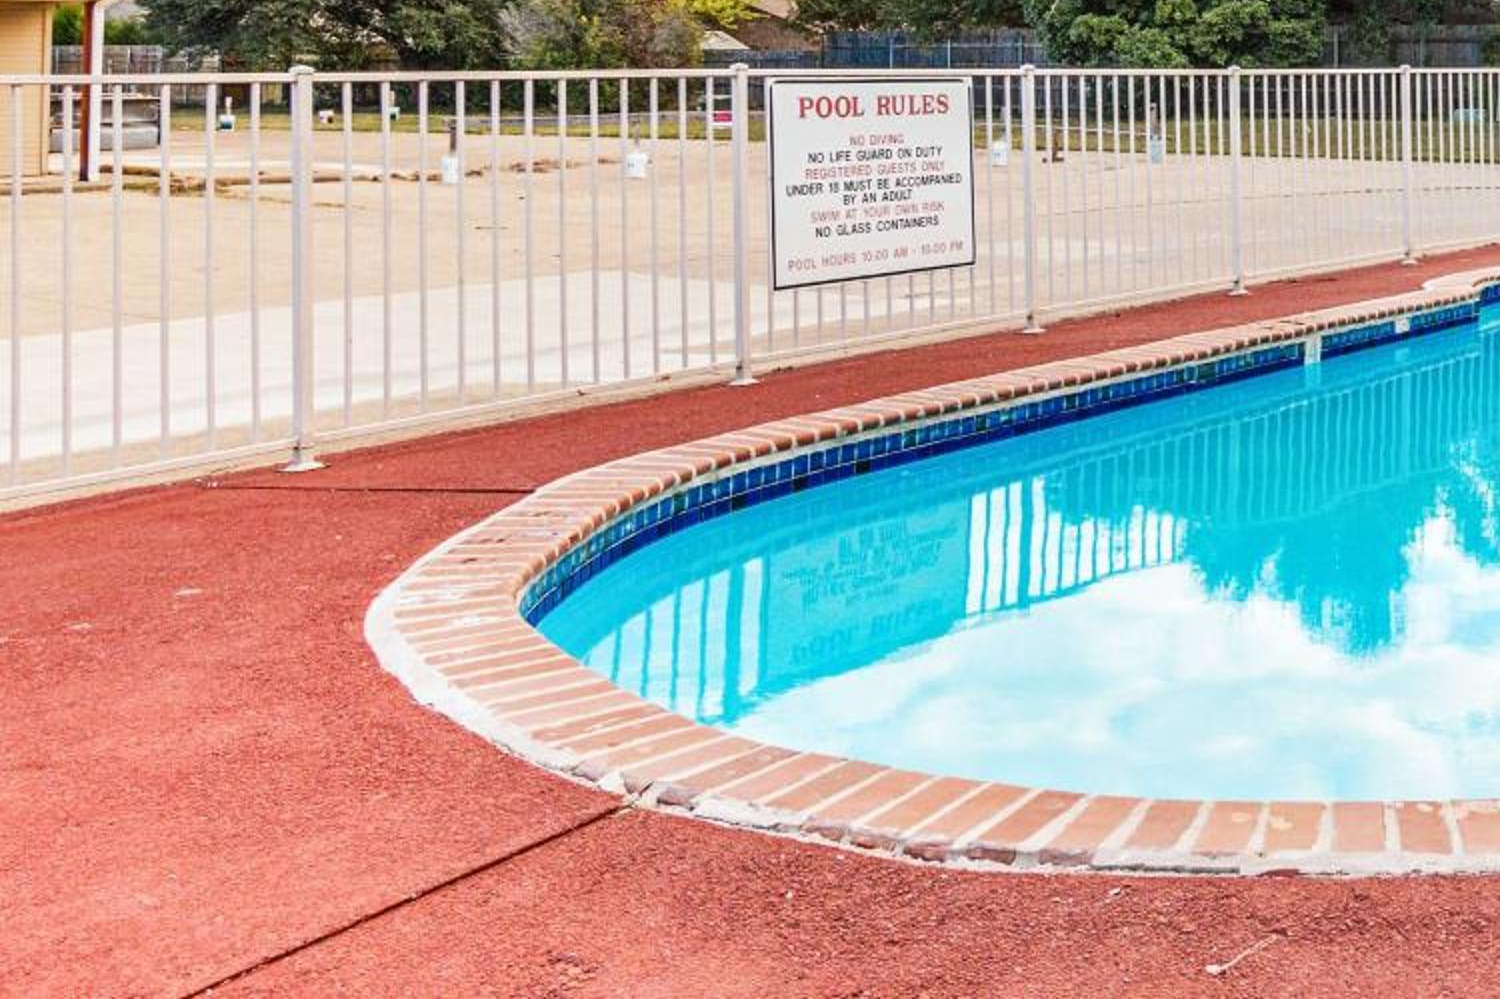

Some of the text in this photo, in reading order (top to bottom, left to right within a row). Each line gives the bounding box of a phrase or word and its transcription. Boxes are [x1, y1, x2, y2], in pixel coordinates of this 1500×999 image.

[799, 94, 950, 118] POOL RULES
[850, 134, 904, 146] NO DIVING
[808, 146, 942, 163] NO LIFE GUARD ON DUTY
[805, 160, 945, 180] REGISTERED GUESTS ONLY
[785, 183, 823, 197] UNDER
[843, 179, 872, 192] MUST
[877, 178, 890, 190] BE
[895, 174, 962, 188] ACCOMPANIED
[843, 189, 913, 205] BY AN ADULT
[810, 201, 945, 223] SWIM AT YOUR OWN RISK
[815, 215, 940, 238] NO GLASS CONTAINERS
[787, 258, 817, 271] POOL
[822, 252, 856, 266] HOURS
